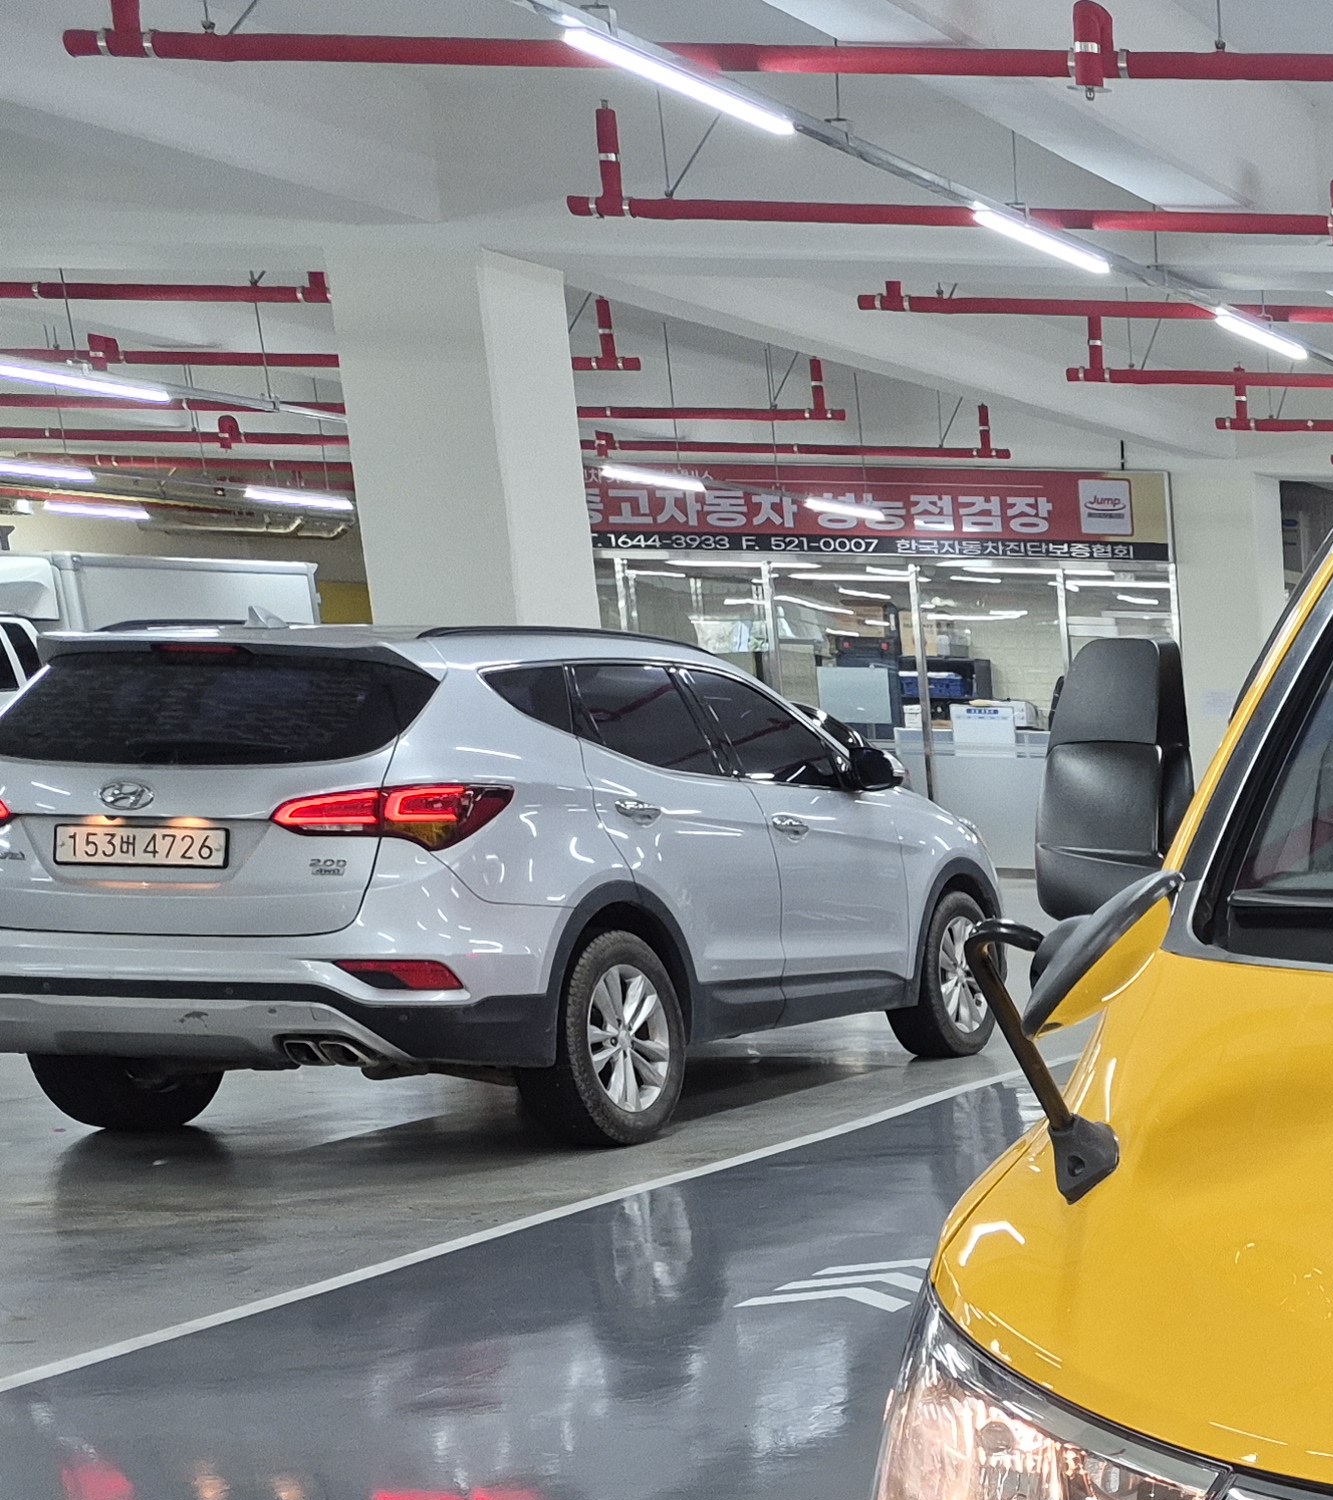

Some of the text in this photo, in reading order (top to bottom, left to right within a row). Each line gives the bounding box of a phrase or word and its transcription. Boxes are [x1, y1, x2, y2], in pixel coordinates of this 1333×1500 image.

[1088, 495, 1121, 508] Jump
[607, 533, 731, 550] 1644-3933
[741, 536, 759, 551] F.
[770, 536, 880, 552] 521-0007
[896, 539, 1135, 559] 한국자동차진단보증협회
[68, 832, 214, 860] 153버 4726
